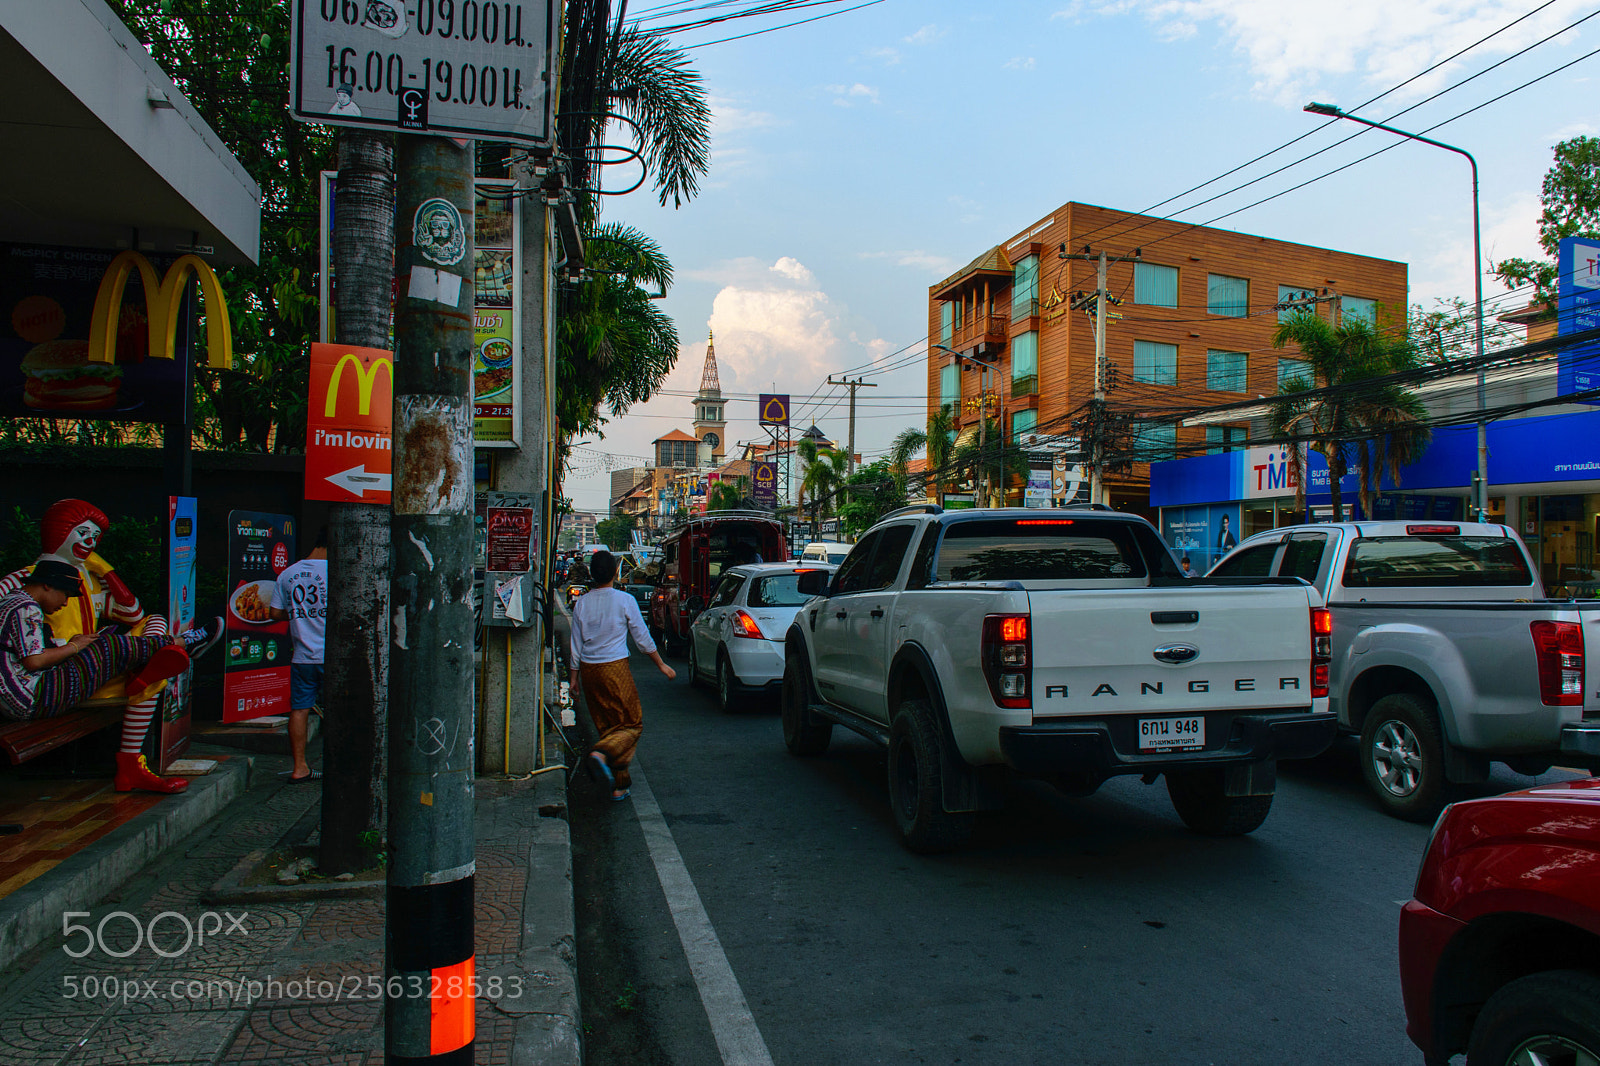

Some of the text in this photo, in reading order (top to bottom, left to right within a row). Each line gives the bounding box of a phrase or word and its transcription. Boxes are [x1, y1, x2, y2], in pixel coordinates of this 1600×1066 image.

[315, 430, 392, 450] i'm lovin
[1326, 476, 1345, 485] BK
[293, 583, 319, 605] 03
[1046, 677, 1300, 698] RANGER
[1141, 719, 1199, 735] 6กน 948
